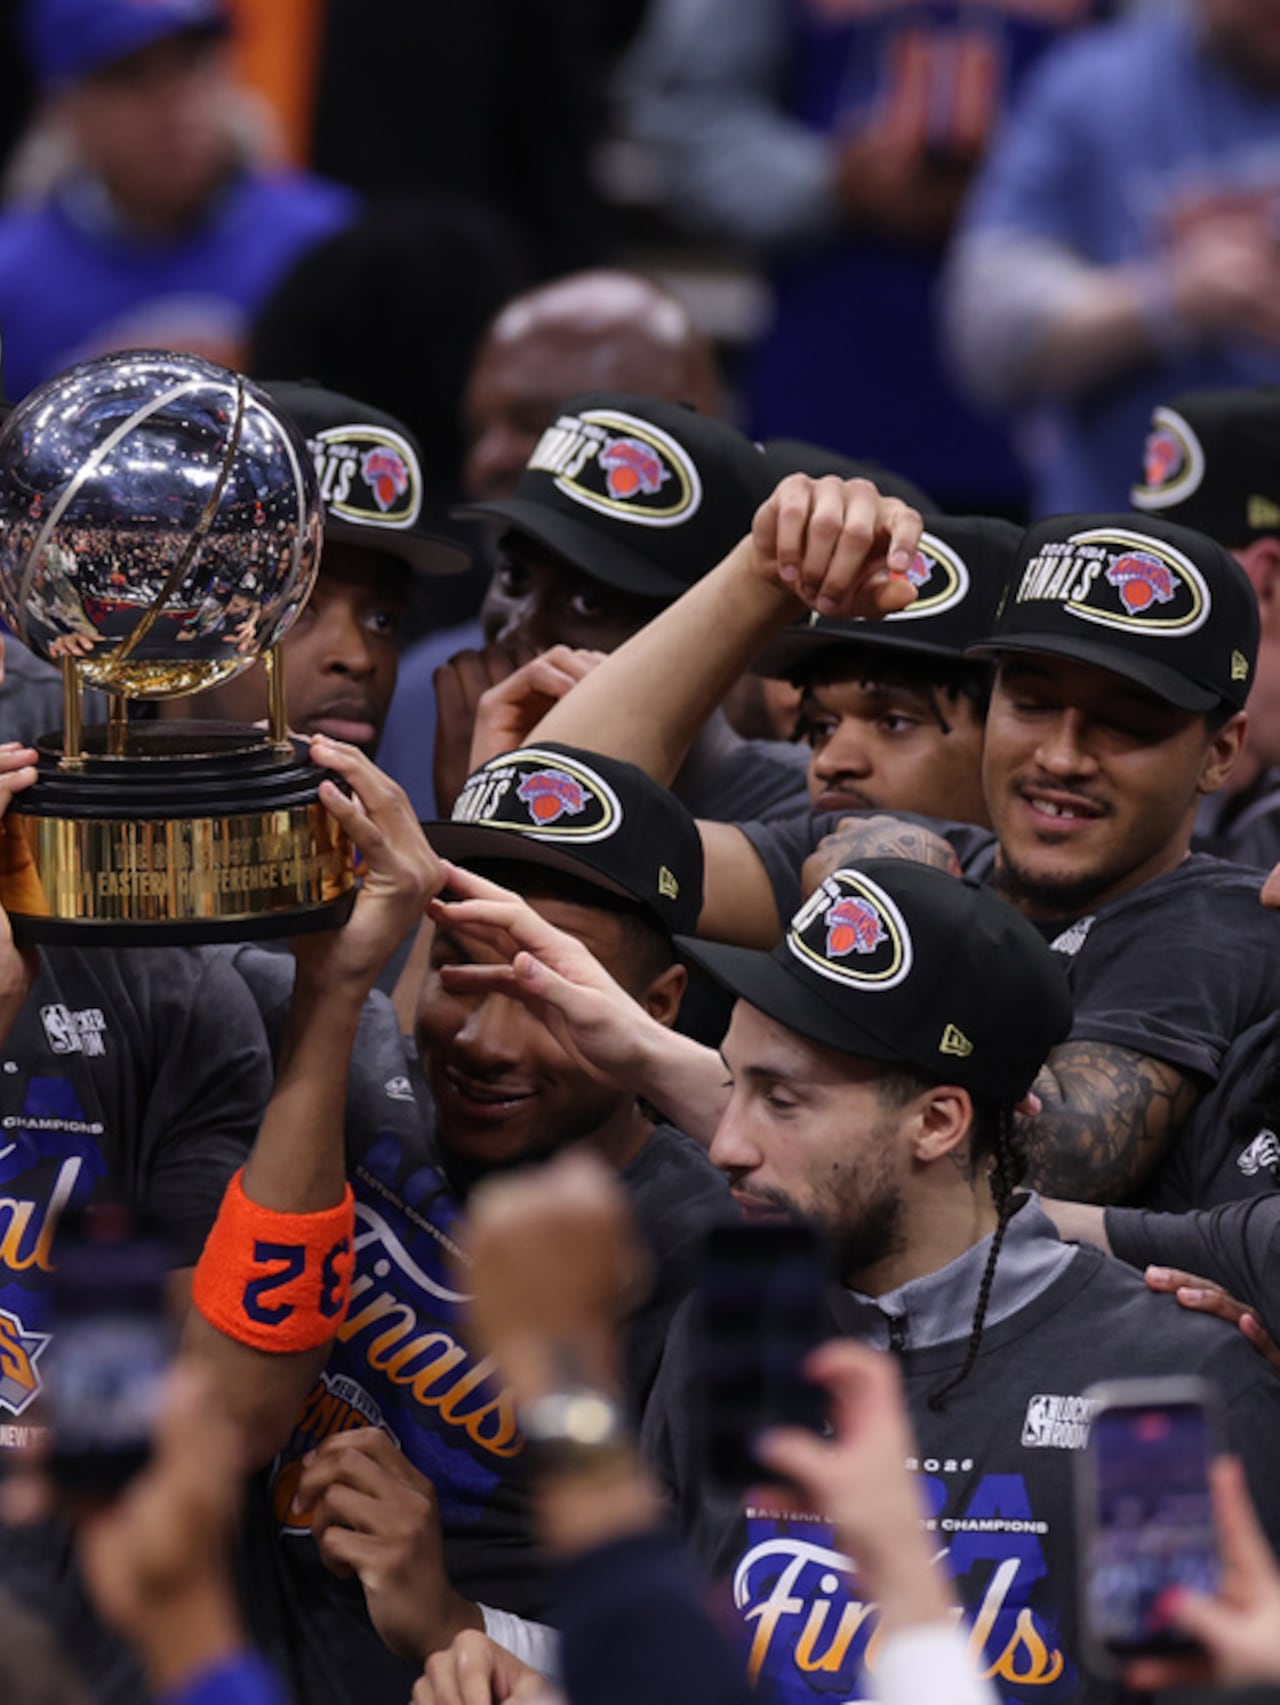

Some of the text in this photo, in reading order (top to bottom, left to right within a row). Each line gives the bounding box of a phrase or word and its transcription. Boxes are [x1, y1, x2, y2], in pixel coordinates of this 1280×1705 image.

[1016, 556, 1103, 604] FINALS
[96, 871, 172, 898] EASTERN
[3, 1115, 105, 1134] CHAMPIONS
[941, 1517, 1049, 1535] CHAMPIONS
[733, 1537, 1065, 1692] Finls
